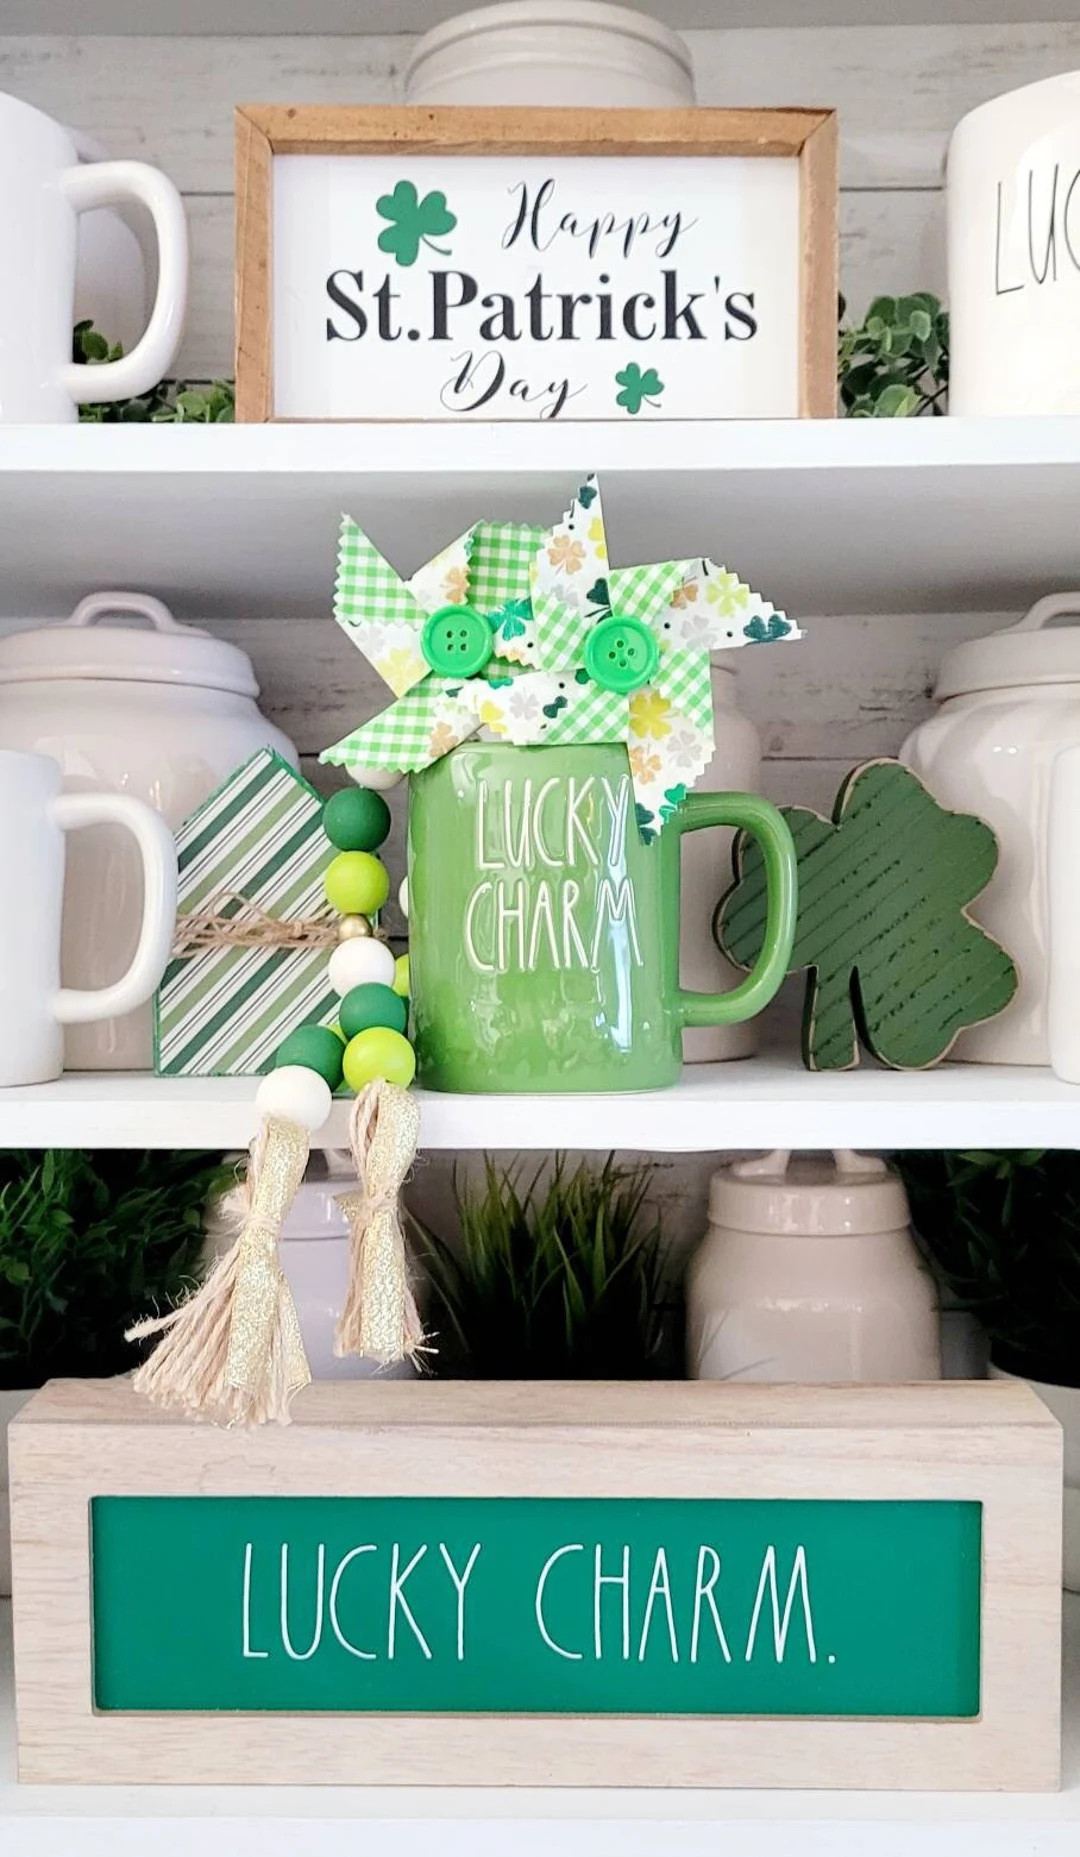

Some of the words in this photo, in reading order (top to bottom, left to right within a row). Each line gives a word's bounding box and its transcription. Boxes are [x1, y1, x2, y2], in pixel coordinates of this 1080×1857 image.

[501, 178, 699, 258] Happy
[440, 350, 588, 418] Day
[478, 773, 629, 869] LUCKY
[465, 878, 643, 972] CHARM
[242, 1542, 481, 1660] LUCKY
[535, 1544, 836, 1663] CHARM.
